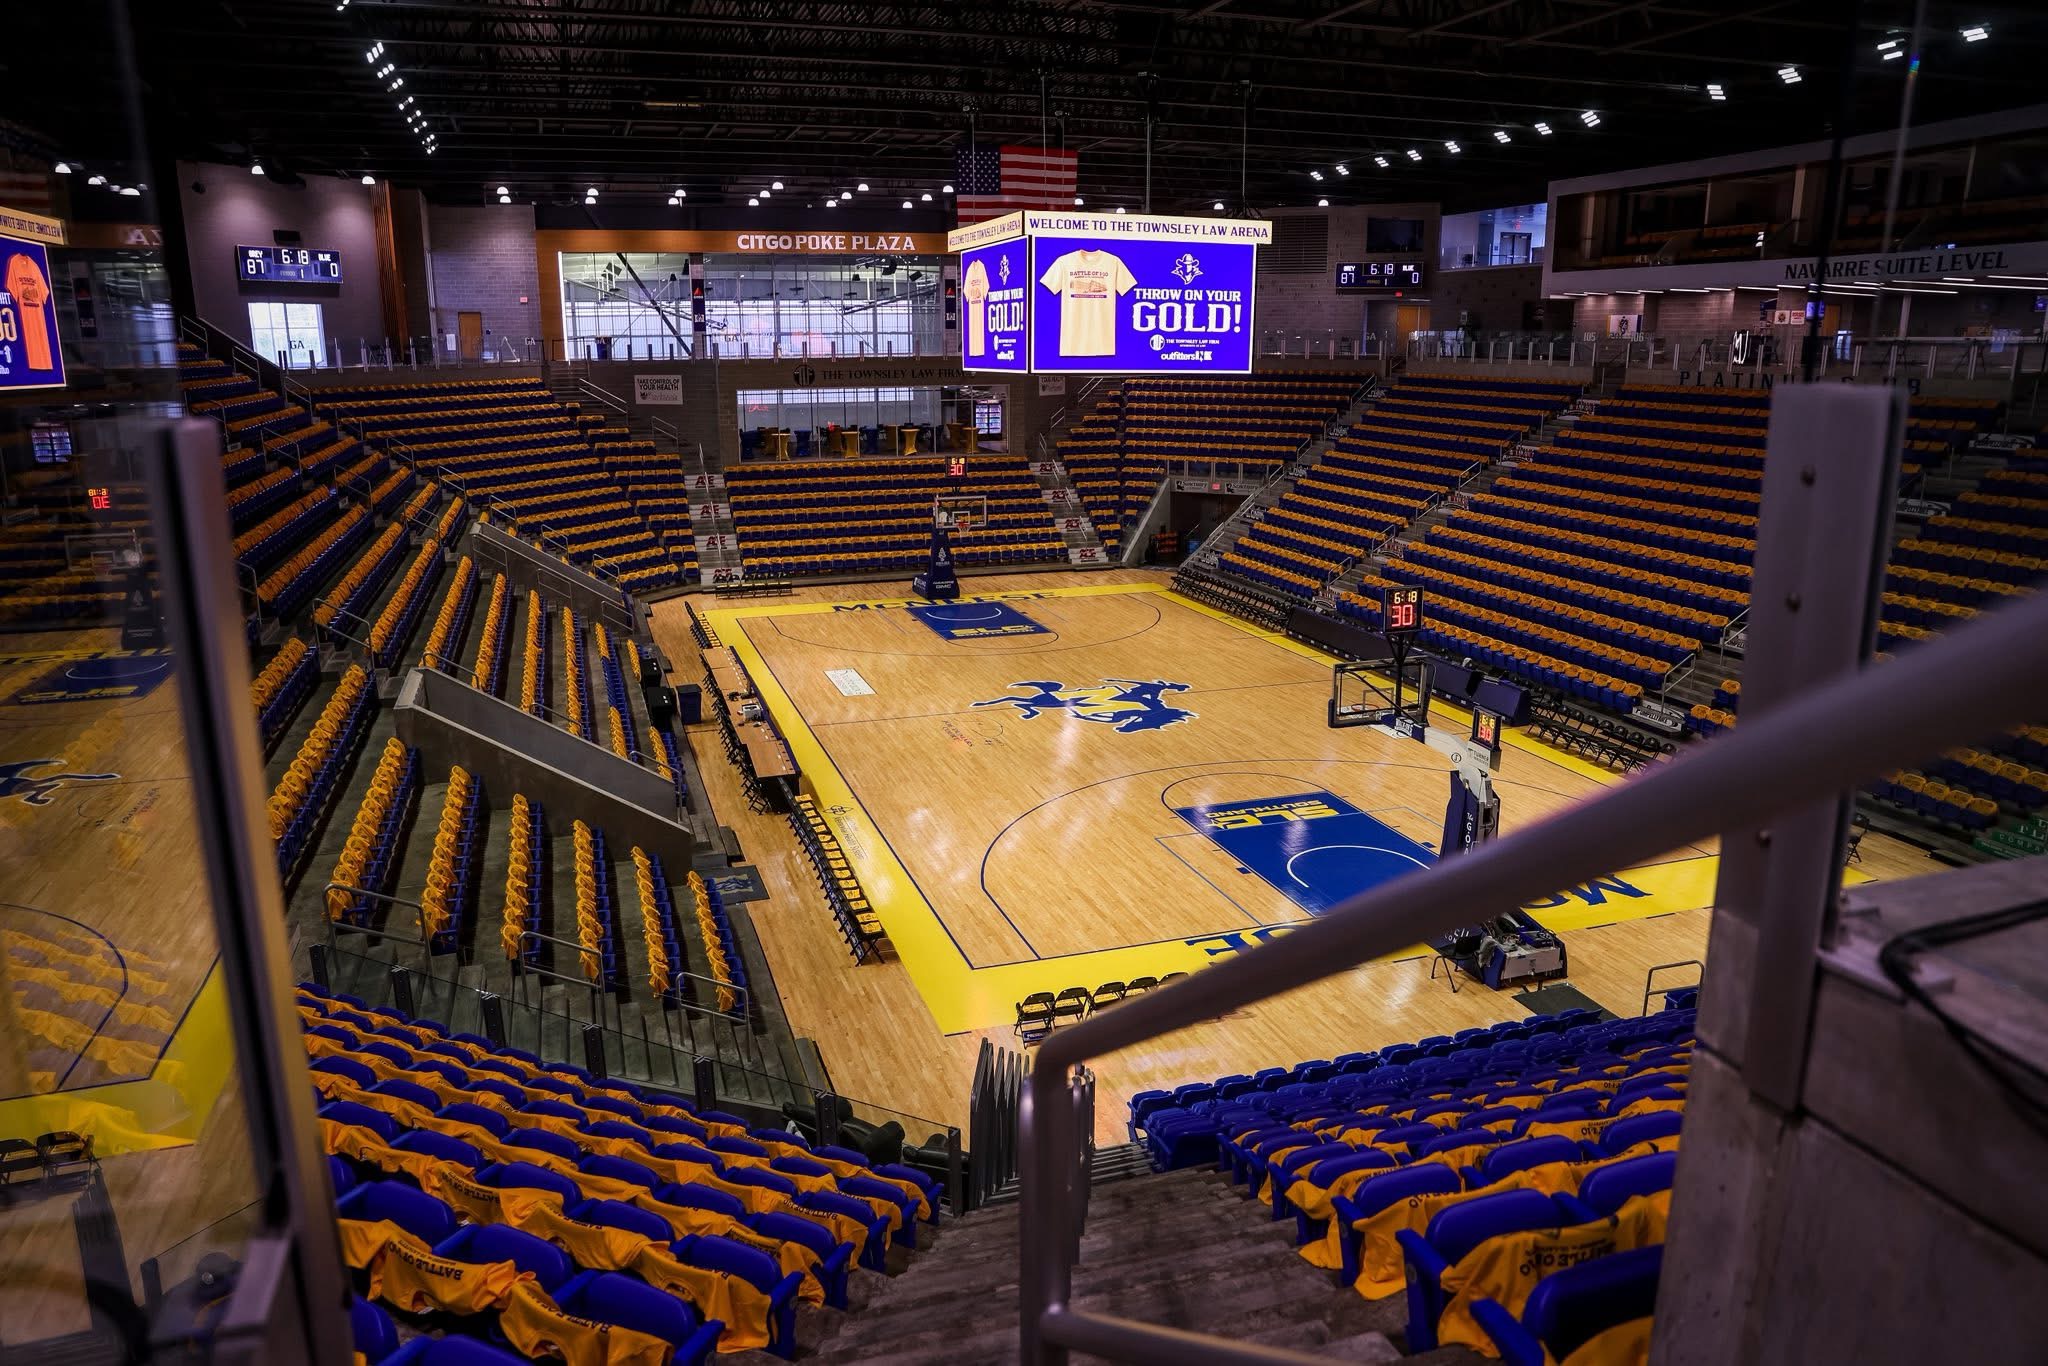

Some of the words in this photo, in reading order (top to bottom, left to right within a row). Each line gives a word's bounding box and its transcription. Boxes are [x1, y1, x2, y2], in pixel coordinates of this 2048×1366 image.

[949, 233, 965, 246] WELCOME
[964, 232, 969, 242] TO
[969, 231, 977, 241] THE
[976, 226, 996, 240] TOWNSLEY
[996, 224, 1006, 235] LAW
[1006, 220, 1021, 232] ARENA
[1029, 217, 1089, 231] WELCOME
[1092, 220, 1107, 232] TO
[1110, 220, 1133, 232] THE
[1135, 222, 1199, 235] TOWNSLEY
[1202, 224, 1228, 237] LAW
[1230, 225, 1268, 238] ARENA
[737, 234, 792, 250] CITGO
[795, 235, 846, 250] POKE
[851, 235, 916, 251] PLAZA
[281, 249, 309, 265] 6:18
[318, 253, 331, 262] BLUE
[1784, 260, 1870, 279] NAVARRE
[1873, 256, 1931, 275] SUITE
[1936, 251, 2009, 272] LEVEL
[246, 258, 265, 274] 87
[329, 262, 339, 278] 0
[1370, 263, 1394, 275] 6:18
[1402, 264, 1415, 272] BLUE
[1340, 272, 1355, 284] 87
[1411, 272, 1419, 284] 0
[988, 290, 1003, 303] THROW
[1003, 289, 1010, 301] ON
[1010, 287, 1024, 300] YOUR
[1133, 288, 1183, 300] THROW
[1184, 289, 1203, 301] ON
[1206, 290, 1241, 302] YOUR
[987, 301, 1024, 333] GOLD!
[1132, 301, 1242, 333] GOLD!
[290, 340, 305, 350] GA
[525, 337, 536, 345] GA
[822, 369, 843, 380] THE
[848, 369, 908, 380] TOWNSLEY
[911, 368, 936, 379] LAW
[938, 368, 965, 379] FIRM
[950, 464, 963, 476] 30
[1394, 590, 1418, 604] 6:18
[1391, 604, 1413, 627] 30
[1205, 799, 1322, 818] SOUTHLAND
[1210, 806, 1340, 830] SLC
[400, 1252, 414, 1265] OF
[415, 1258, 464, 1281] BATTLE
